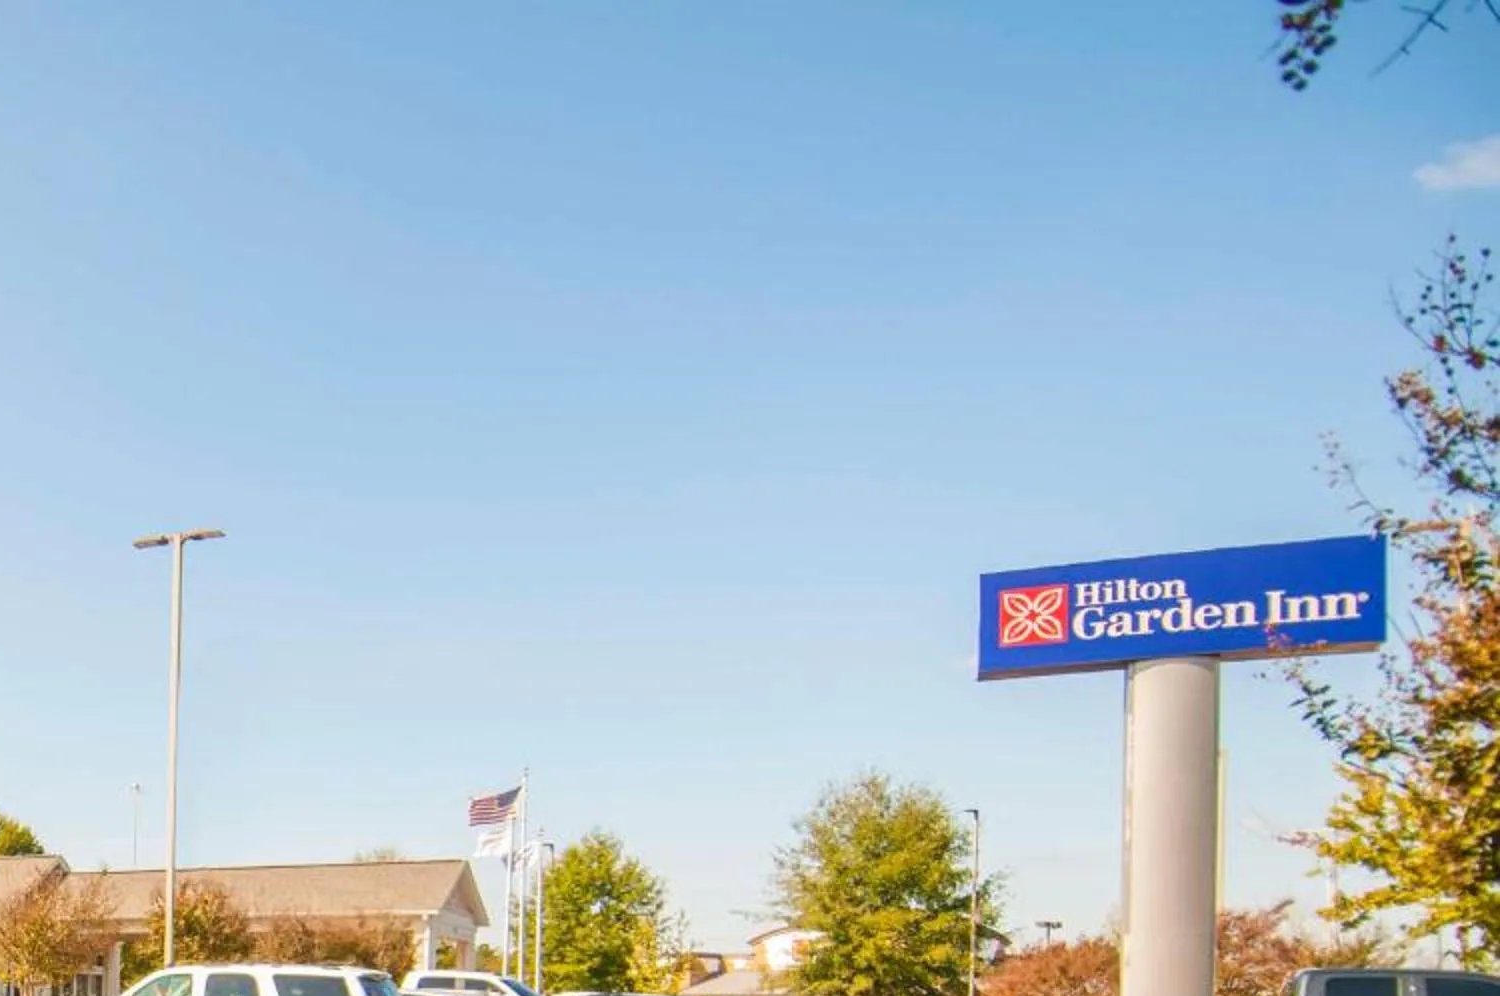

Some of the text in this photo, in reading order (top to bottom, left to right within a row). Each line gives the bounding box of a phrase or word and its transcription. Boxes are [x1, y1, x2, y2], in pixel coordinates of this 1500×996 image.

[1073, 577, 1189, 607] Hilton
[1072, 589, 1362, 640] Garden Inn
